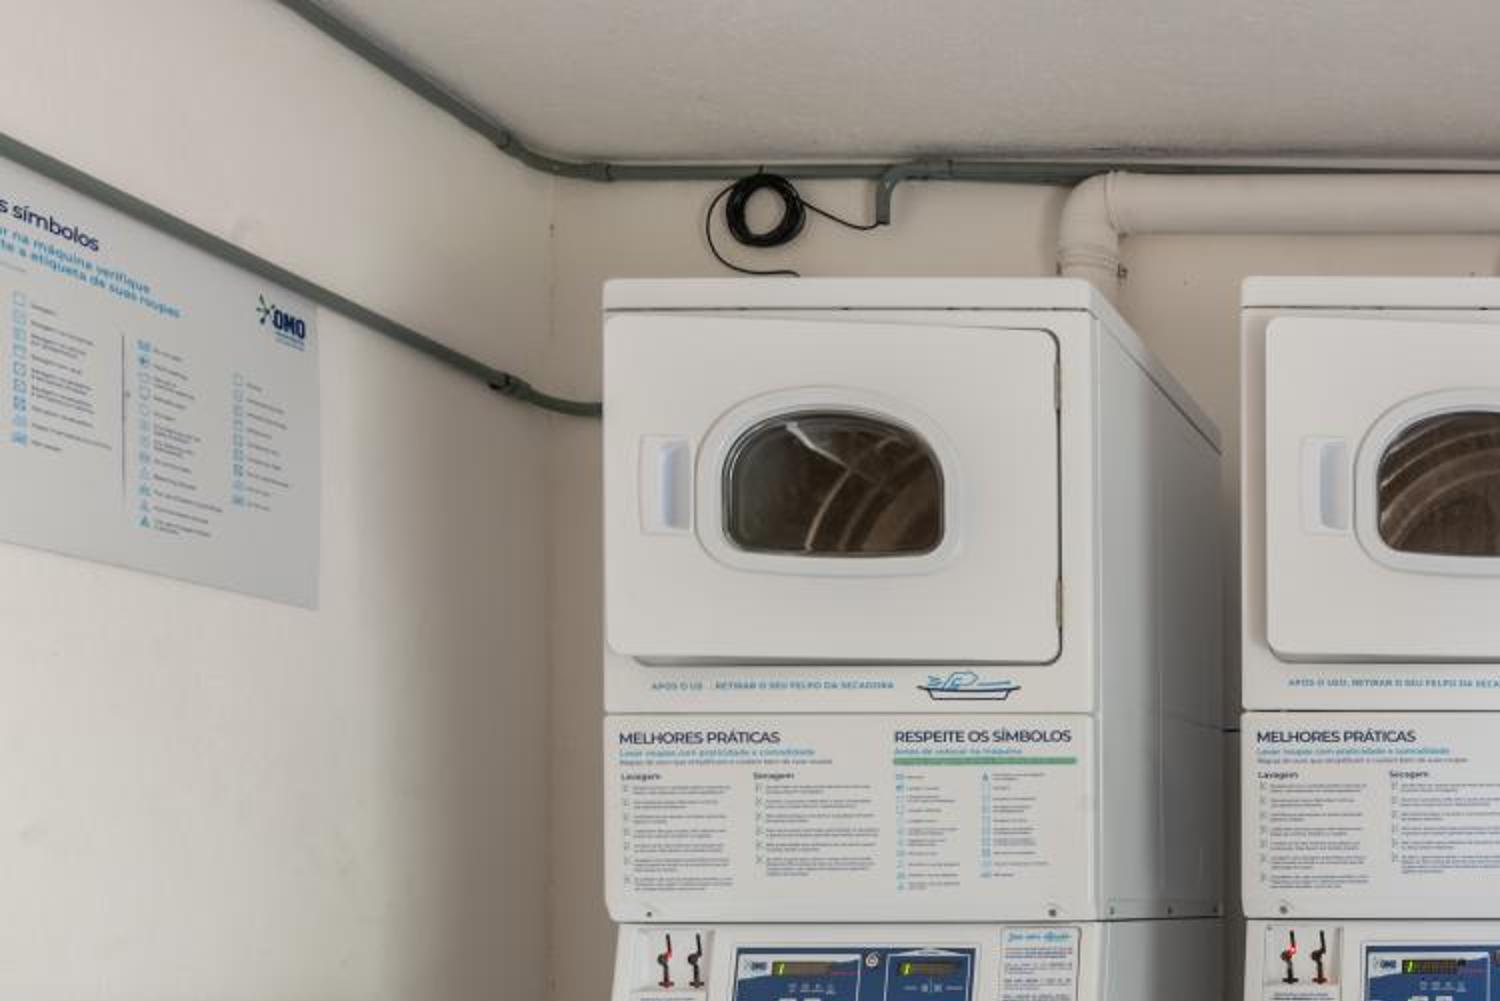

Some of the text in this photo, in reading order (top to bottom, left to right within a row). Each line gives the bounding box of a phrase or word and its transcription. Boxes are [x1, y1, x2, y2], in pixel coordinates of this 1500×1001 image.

[13, 205, 99, 251] símbolos
[272, 308, 305, 340] OMO
[619, 728, 781, 744] MELHORES PRÁTICAS
[895, 727, 1072, 743] RESPEITE OS SÍMBOLOS
[1257, 728, 1417, 743] MELHORES PRÁTICAS
